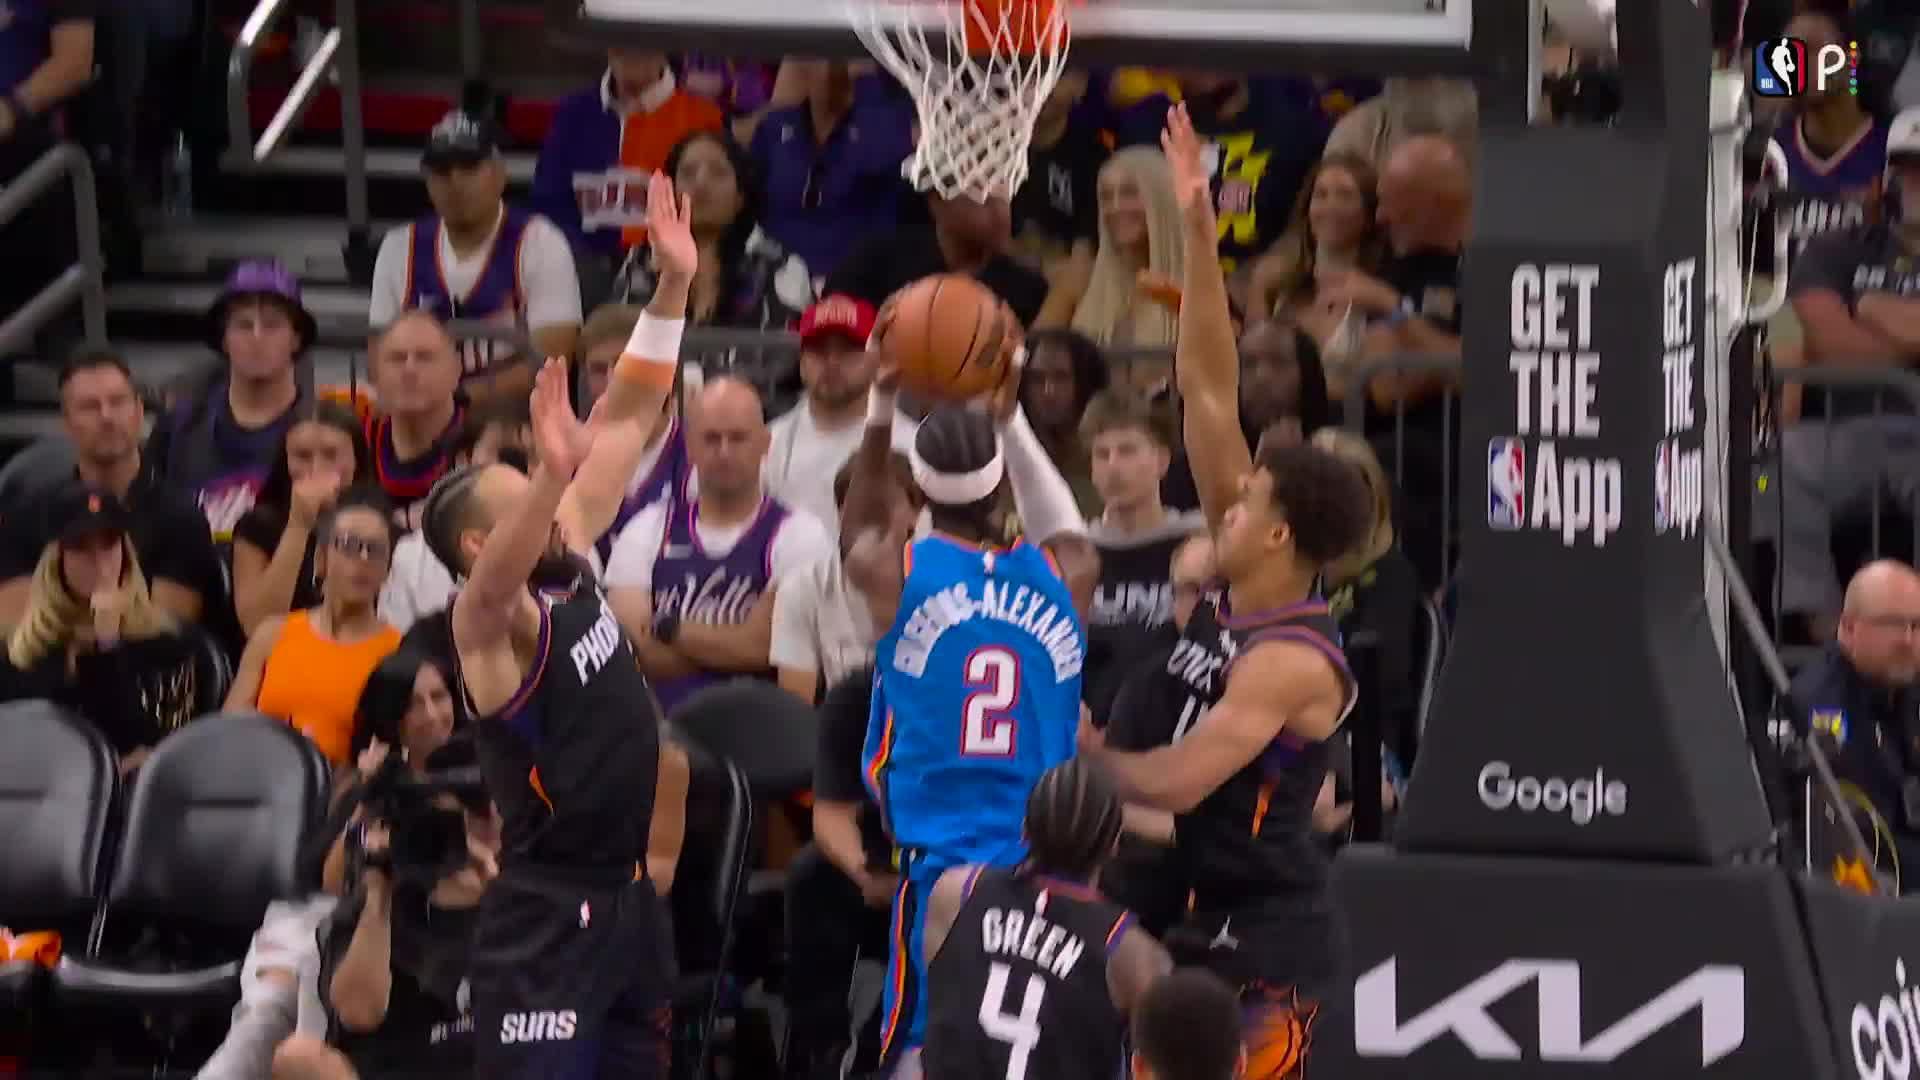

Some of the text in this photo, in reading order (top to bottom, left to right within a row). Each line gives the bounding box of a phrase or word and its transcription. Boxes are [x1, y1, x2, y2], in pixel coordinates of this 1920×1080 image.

[1510, 262, 1600, 351] GET
[1663, 256, 1696, 349] GET
[1509, 351, 1600, 438] THE
[1662, 345, 1695, 437] THE
[1530, 439, 1623, 548] App
[1669, 436, 1702, 540] App
[962, 645, 1020, 757] 2
[1477, 760, 1627, 825] Google
[982, 906, 1086, 981] GREEN
[978, 960, 1047, 1080] 4
